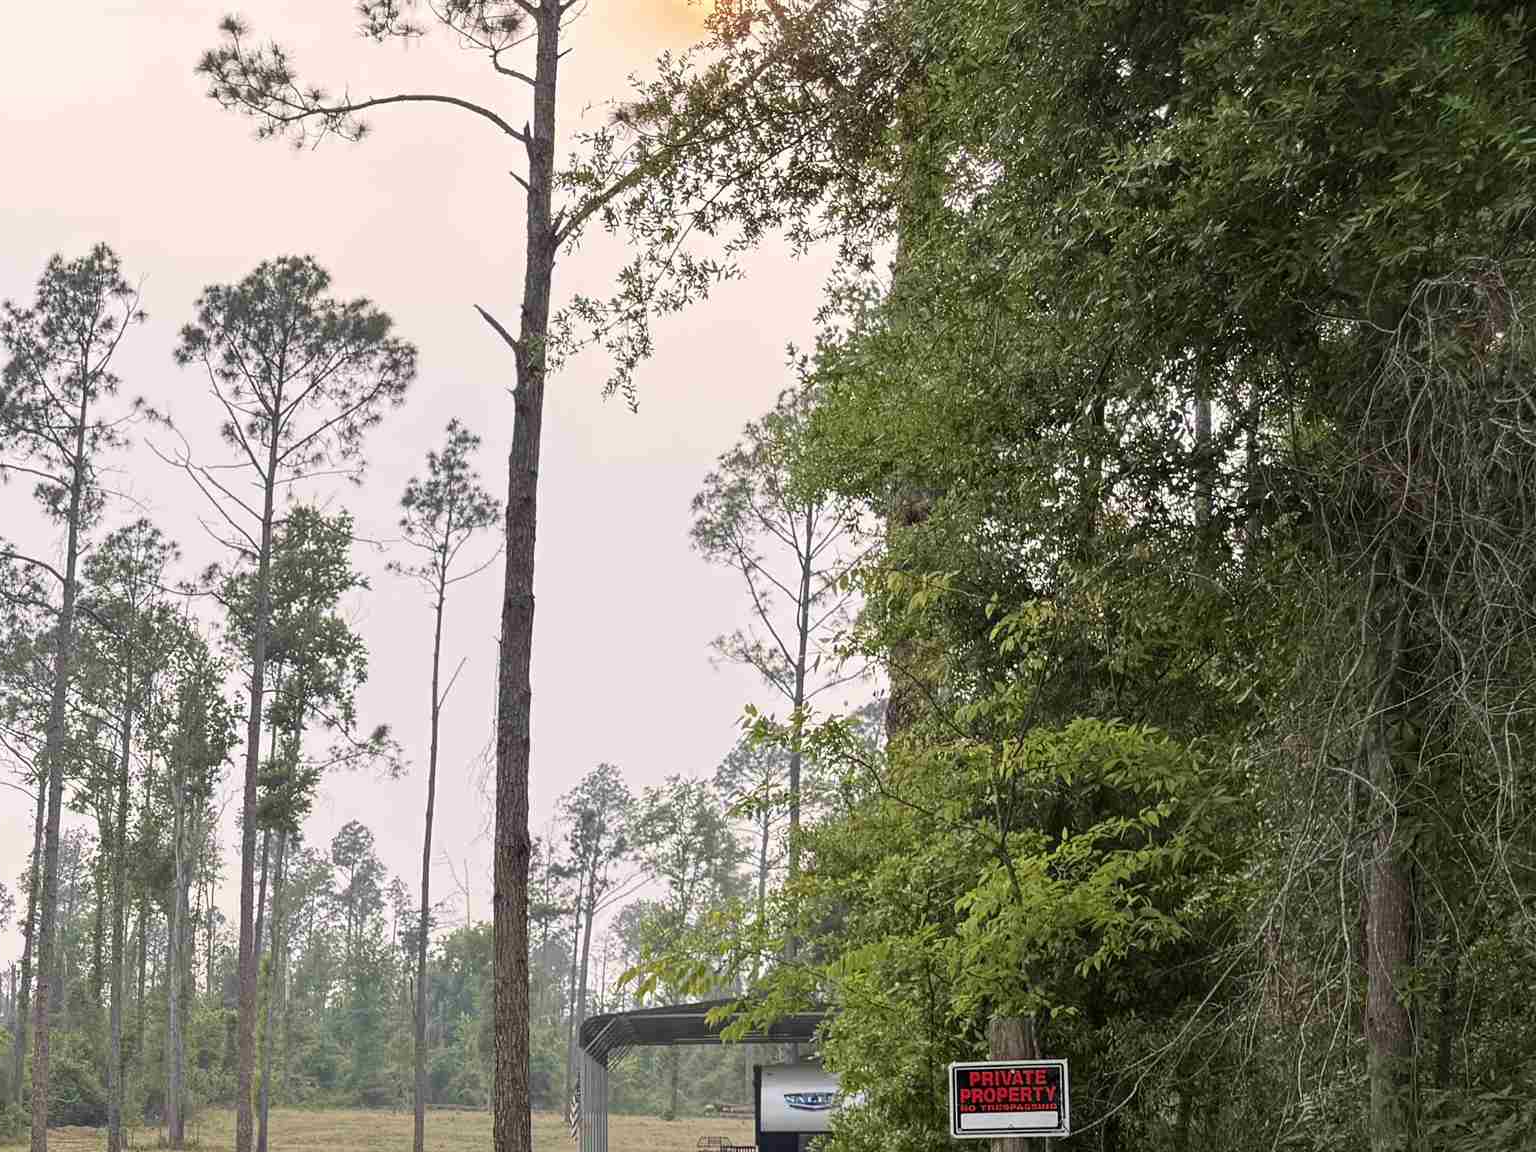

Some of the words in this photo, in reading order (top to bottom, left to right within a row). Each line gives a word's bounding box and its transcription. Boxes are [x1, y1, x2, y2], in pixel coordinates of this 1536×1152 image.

[969, 1070, 1047, 1086] PRIVATE
[960, 1087, 1056, 1103] PROPERTY
[981, 1103, 1057, 1112] TRESPASSING
